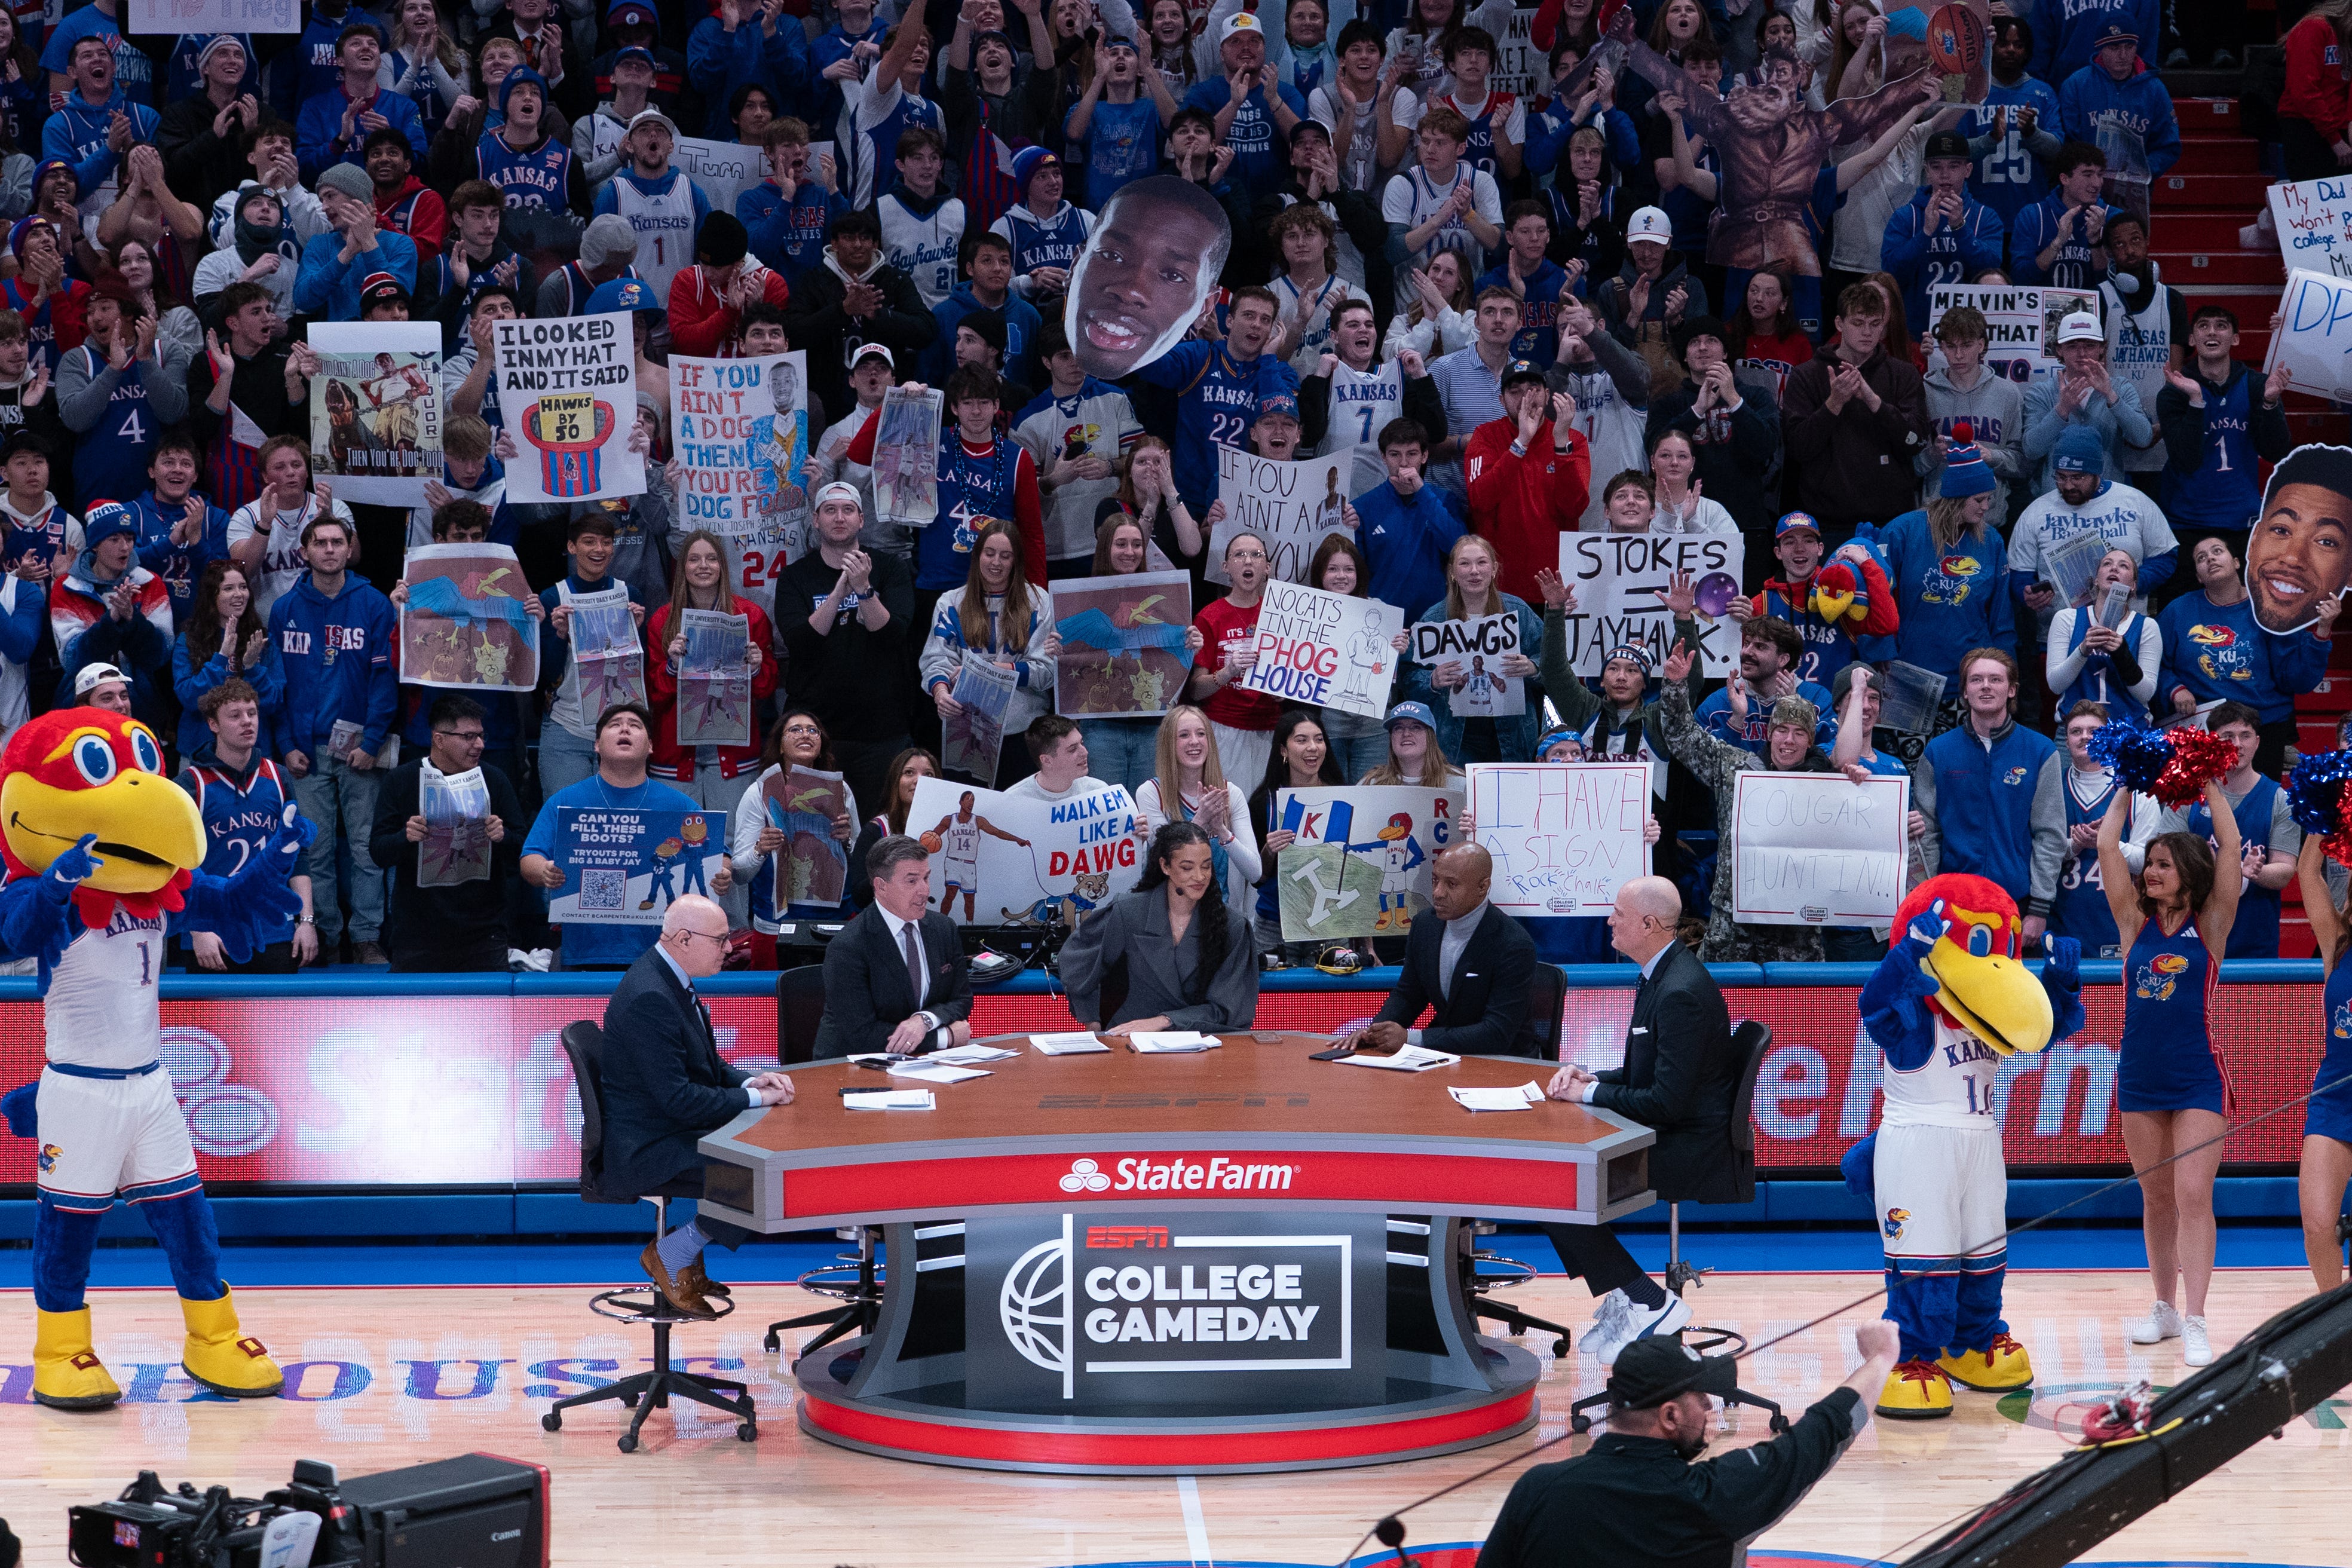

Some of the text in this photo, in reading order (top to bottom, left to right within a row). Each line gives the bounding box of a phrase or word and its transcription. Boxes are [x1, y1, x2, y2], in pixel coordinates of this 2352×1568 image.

[679, 145, 743, 179] Tum
[1982, 130, 2032, 183] 25
[489, 166, 557, 192] KANSAS
[2172, 179, 2182, 189] 10
[2283, 181, 2346, 215] My Dad
[631, 214, 690, 231] Kansas
[653, 236, 666, 266] 1
[2054, 246, 2092, 262] ANSAS
[2293, 231, 2337, 252] college
[1022, 244, 1076, 267] KANSA
[2197, 256, 2204, 267] 9
[1925, 261, 1964, 293] 22
[1934, 291, 2039, 311] MELVIN'S
[500, 320, 614, 346] I LOOKED
[2112, 347, 2170, 363] JAYHAWKS
[353, 360, 359, 378] A
[359, 360, 376, 379] DOG
[506, 365, 629, 390] AND IT SAID
[678, 362, 761, 388] IF YOU
[540, 397, 592, 412] HAWKS
[680, 390, 745, 415] AIN'T
[1334, 384, 1397, 403] KANSAS
[117, 408, 146, 444] 4
[559, 413, 577, 425] BY
[680, 415, 696, 439] A
[1209, 414, 1245, 446] 22
[1355, 406, 1376, 444] 7
[1585, 415, 1594, 443] 1
[2205, 416, 2249, 436] ANSAS
[556, 424, 580, 442] 50
[346, 448, 443, 468] THEN YOU'RE DOG FOOD
[682, 443, 746, 468] THEN
[2214, 436, 2234, 472] 1
[682, 468, 768, 495] YOU'RE
[1220, 446, 1297, 497] IF YOU
[686, 485, 804, 519] DOG FOOD
[1235, 490, 1311, 535] AIN'T A
[2040, 507, 2137, 532] Jayhawks
[742, 550, 788, 588] 24
[1576, 536, 1728, 580] STOKES
[1939, 578, 1954, 590] KU
[608, 592, 627, 602] KANSAN
[694, 615, 720, 624] UNIVERSITY
[1418, 614, 1518, 659] DAWGS
[1257, 633, 1339, 677] PHOG
[2217, 649, 2236, 664] KU
[998, 670, 1016, 682] KANSAN
[1248, 663, 1331, 705] HOUSE
[2093, 666, 2112, 705] 1
[2319, 681, 2326, 693] 4
[1787, 707, 1804, 718] KU
[462, 773, 480, 783] KANSAN
[1051, 788, 1127, 825] WALK EM'
[1477, 768, 1642, 832] I HAVE
[1743, 786, 1873, 829] COUGAR
[210, 810, 279, 838] KANSAS
[570, 823, 646, 835] FILL THESE
[578, 813, 640, 825] CAN YOU
[1079, 814, 1135, 844] LIKE A
[580, 834, 635, 844] BOOTS?
[951, 829, 976, 837] KANSAS
[957, 837, 971, 851] 14
[568, 856, 585, 865] BIG
[596, 857, 621, 865] BABY
[622, 858, 642, 866] JAY
[572, 849, 639, 858] TRYOUTS FOR
[1049, 838, 1136, 877] DAWG
[1391, 854, 1397, 865] 1
[1484, 834, 1625, 873] A SIGN
[2062, 860, 2105, 892] 34
[136, 941, 153, 987] 1
[1943, 1038, 1999, 1068] KANSA
[1115, 1157, 1293, 1191] State Farm
[1086, 1226, 1169, 1248] ESPN
[1085, 1263, 1303, 1302] COLLEGE
[1085, 1305, 1321, 1343] GAMEDAY
[491, 1528, 522, 1544] Canon
